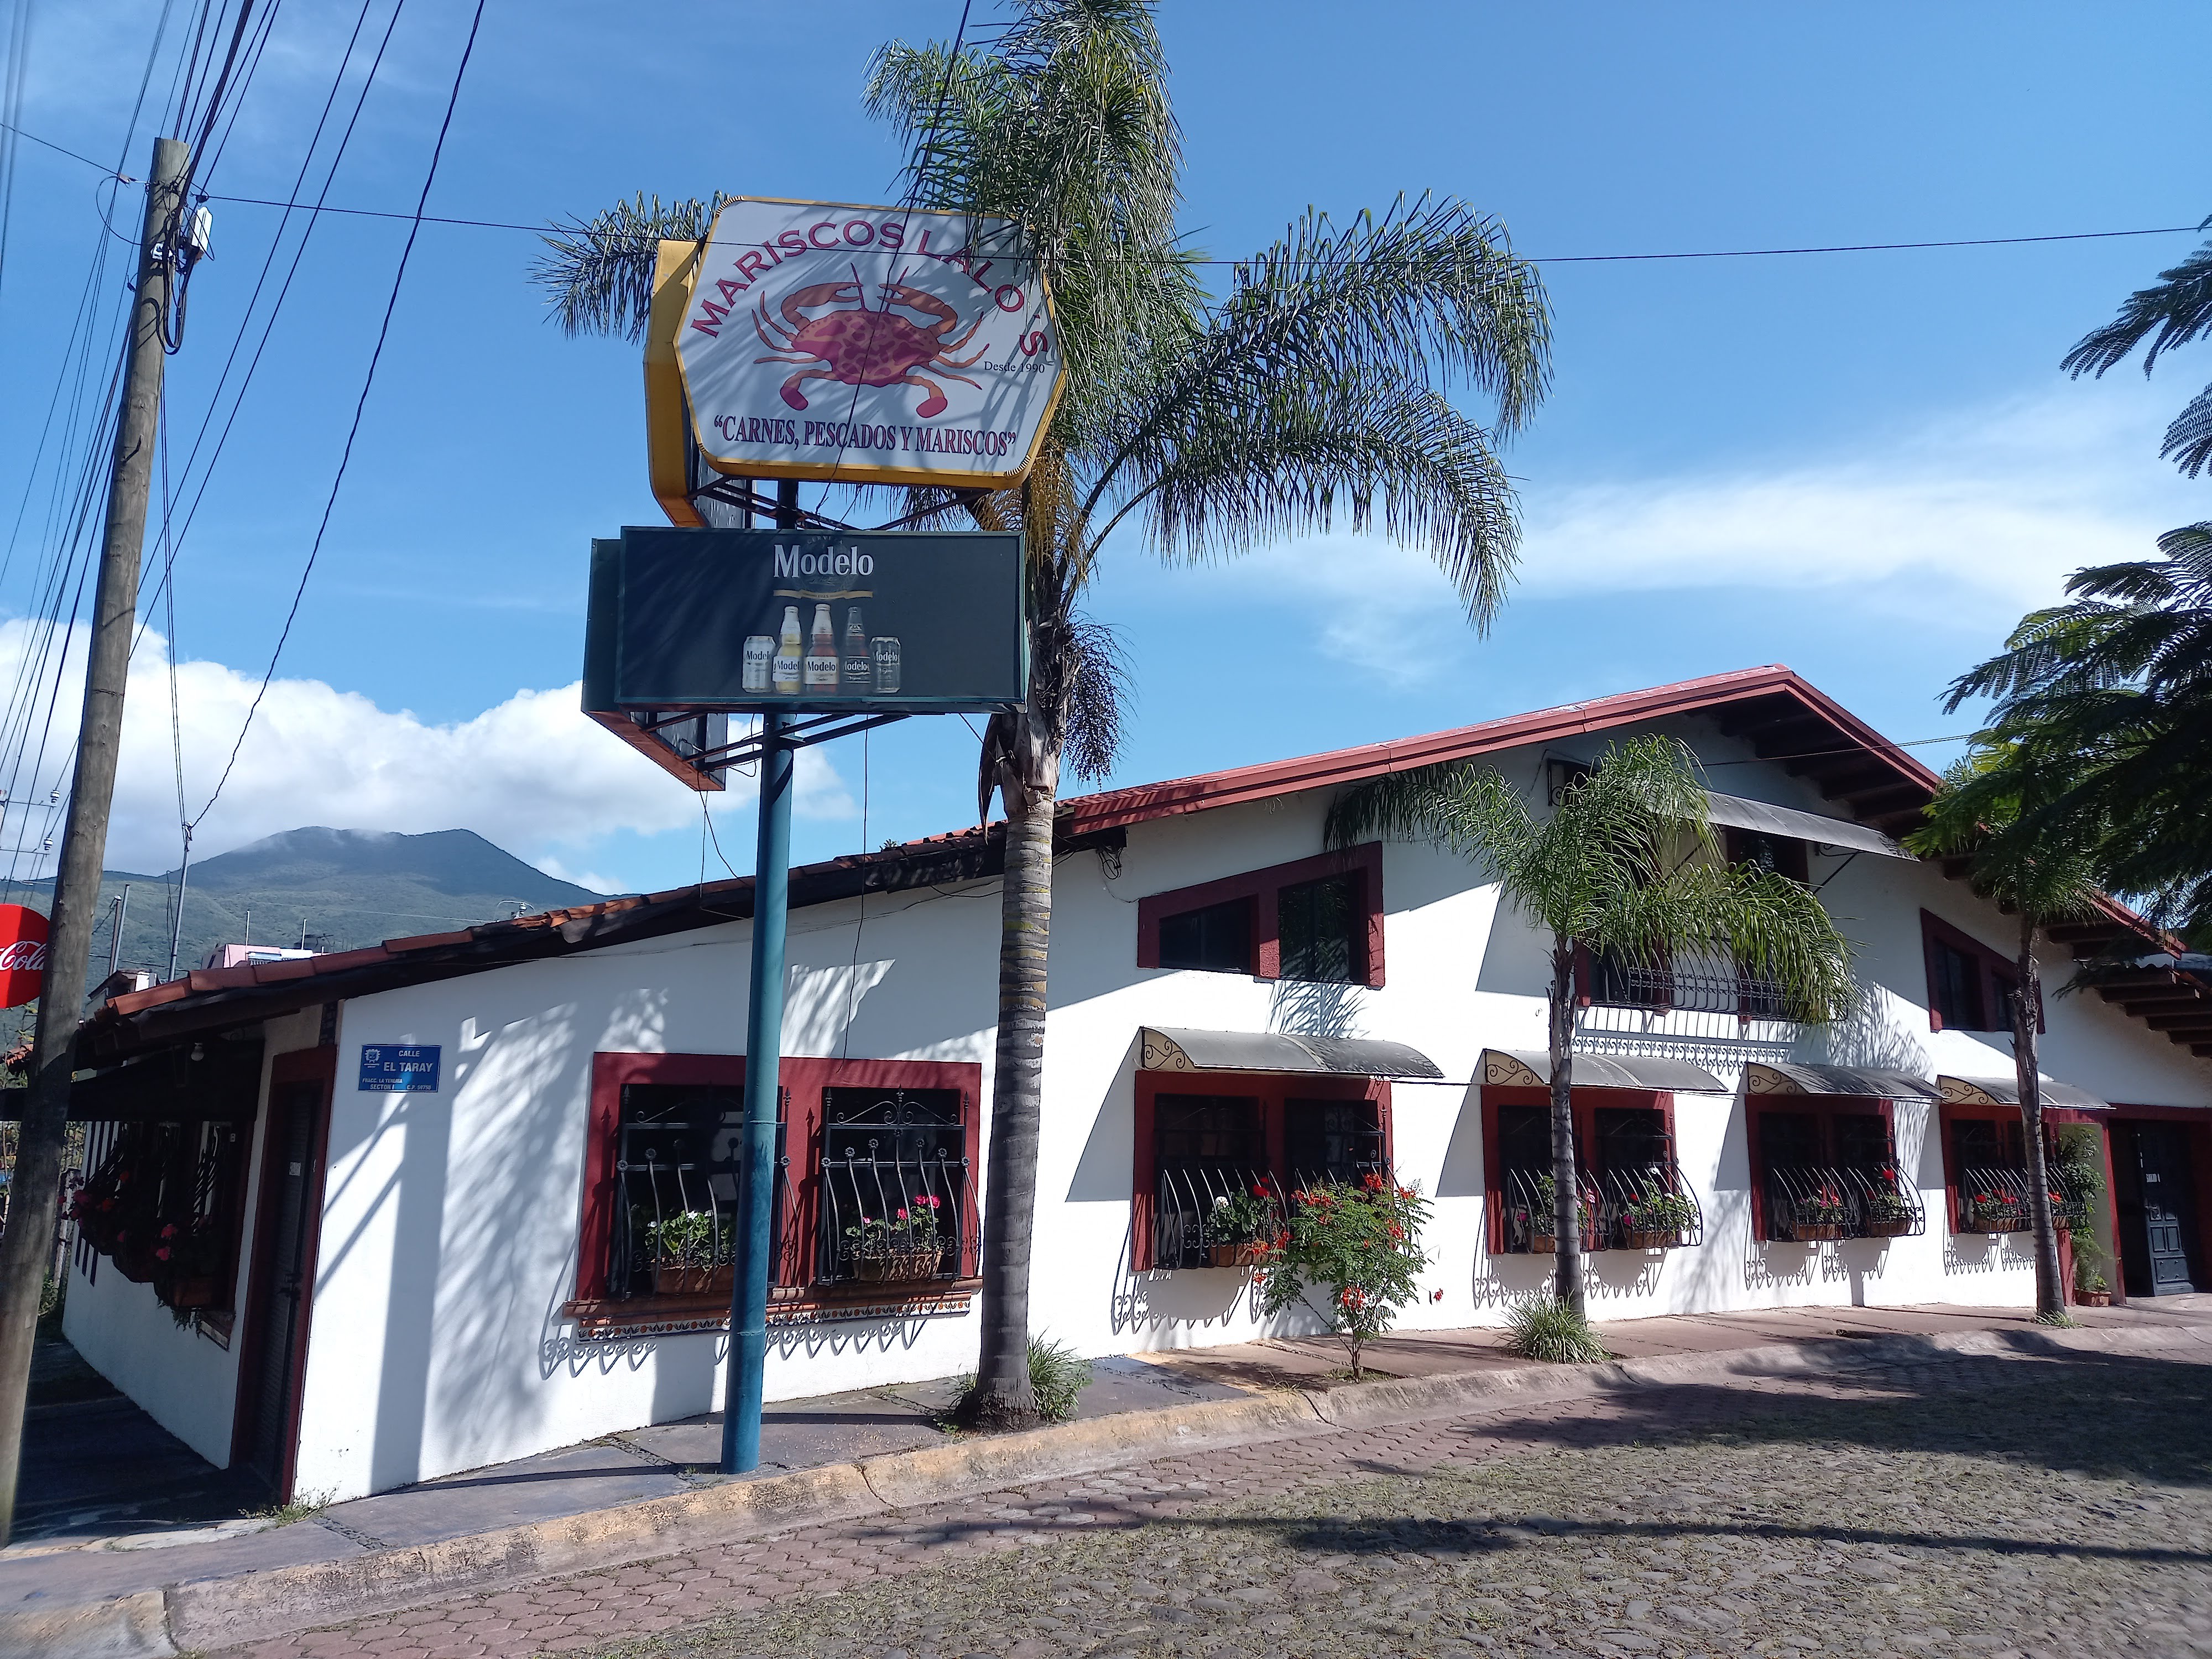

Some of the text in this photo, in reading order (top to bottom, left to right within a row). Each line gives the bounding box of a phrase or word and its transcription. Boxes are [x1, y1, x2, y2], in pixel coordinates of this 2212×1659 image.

[691, 220, 904, 338] MARISCOS
[984, 361, 1045, 373] Desde 1990
[803, 420, 896, 451] PESCADOS
[900, 426, 913, 451] Y
[774, 544, 874, 578] Modelo
[807, 661, 836, 671] Modelo
[384, 1062, 396, 1072] EL
[399, 1062, 433, 1072] TARAY
